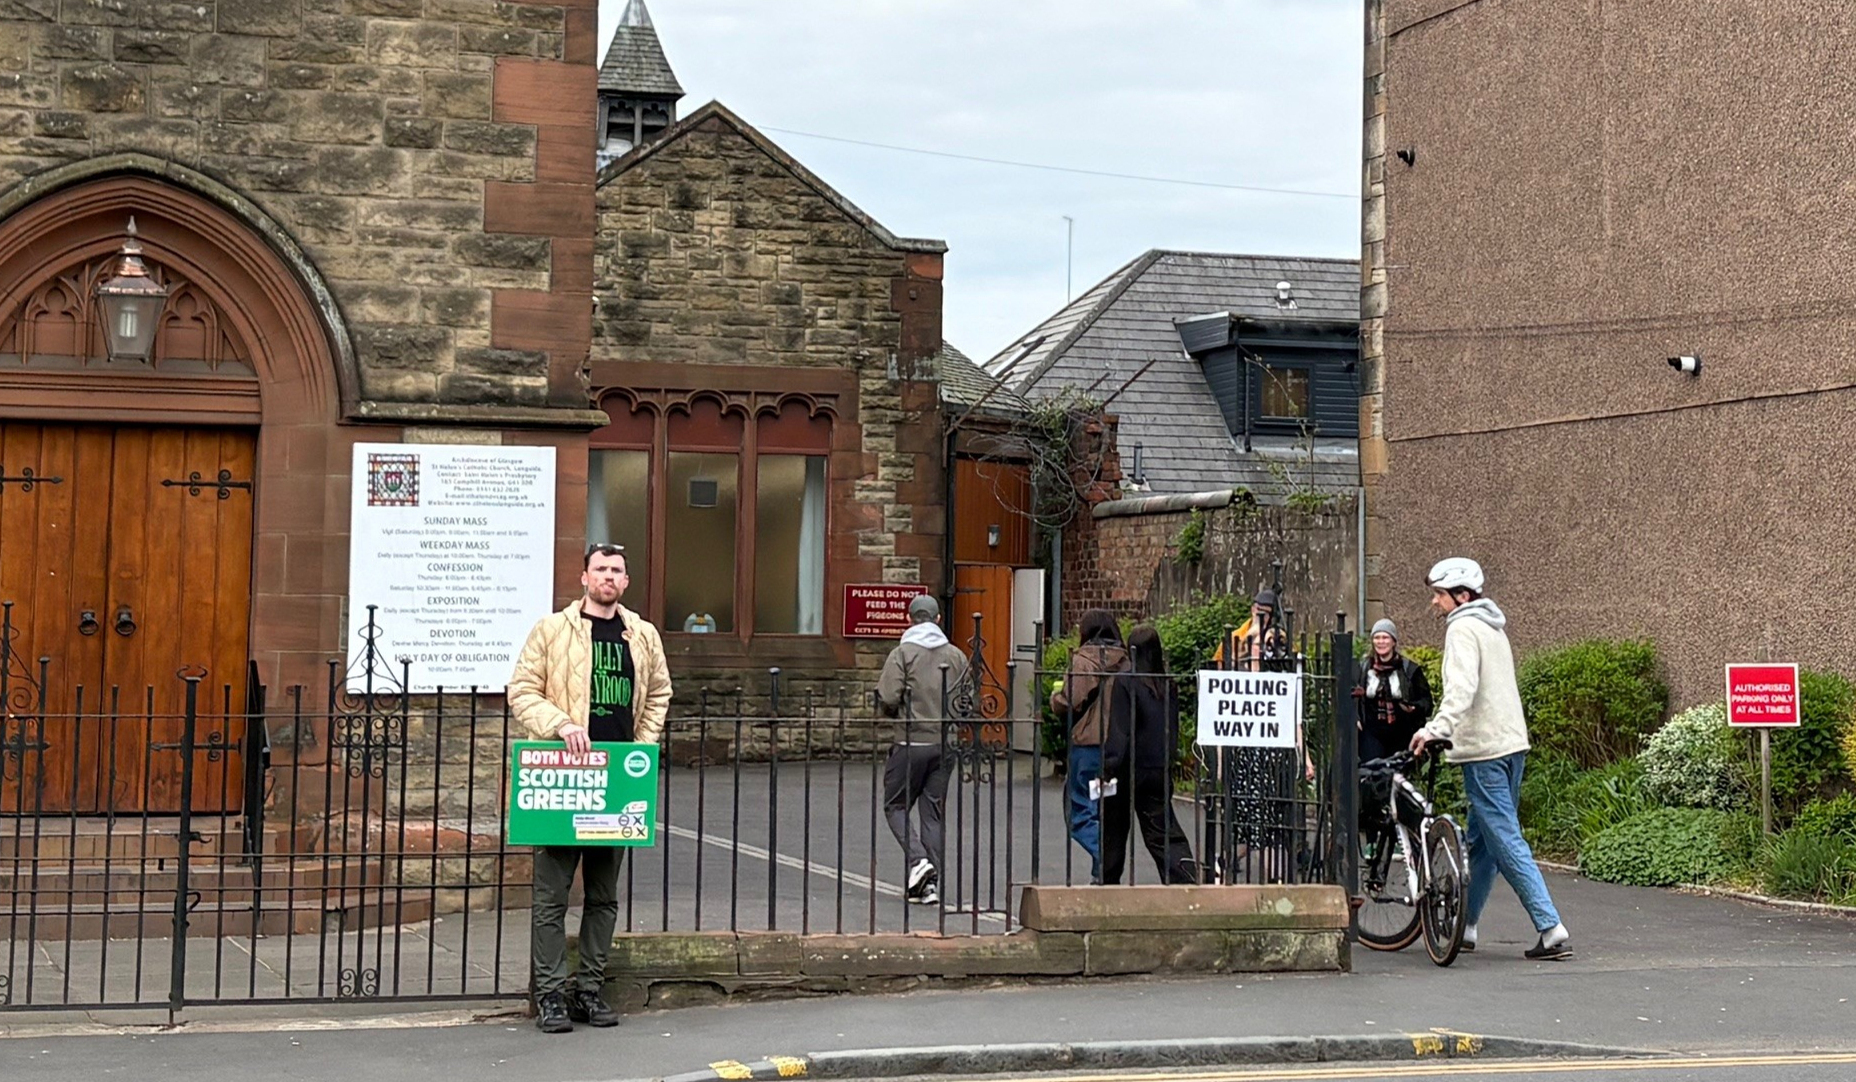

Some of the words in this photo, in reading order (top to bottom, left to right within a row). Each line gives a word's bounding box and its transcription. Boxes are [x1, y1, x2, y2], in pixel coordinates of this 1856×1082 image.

[423, 516, 461, 525] SUNDAY
[463, 517, 488, 526] MASS
[420, 540, 463, 549] WEEKDAY
[465, 541, 490, 550] MASS
[427, 562, 483, 572] CONFESSION
[852, 589, 885, 598] PLEASE
[886, 590, 900, 599] DO
[901, 591, 921, 599] NOT
[427, 596, 480, 605] EXPOSITION
[866, 600, 888, 609] FEED
[889, 601, 906, 609] THE
[866, 611, 905, 620] PIGEONS
[429, 629, 476, 638] DEVOTION
[420, 653, 440, 662] DAY
[441, 653, 454, 662] OF
[455, 653, 510, 663] OBLIGATION
[1208, 678, 1288, 696] POLLING
[1734, 683, 1791, 692] AUTHORISED
[1732, 694, 1770, 703] PARKING
[1770, 694, 1794, 703] ONLY
[1218, 699, 1277, 717] PLACE
[1735, 705, 1747, 714] AT
[1747, 705, 1764, 714] ALL
[1764, 705, 1792, 714] TIMES
[1213, 720, 1255, 737] WAY
[1260, 721, 1279, 738] IN
[520, 750, 560, 765] BOTH
[517, 768, 608, 788] SCOTTISH
[517, 788, 607, 811] GREENS
